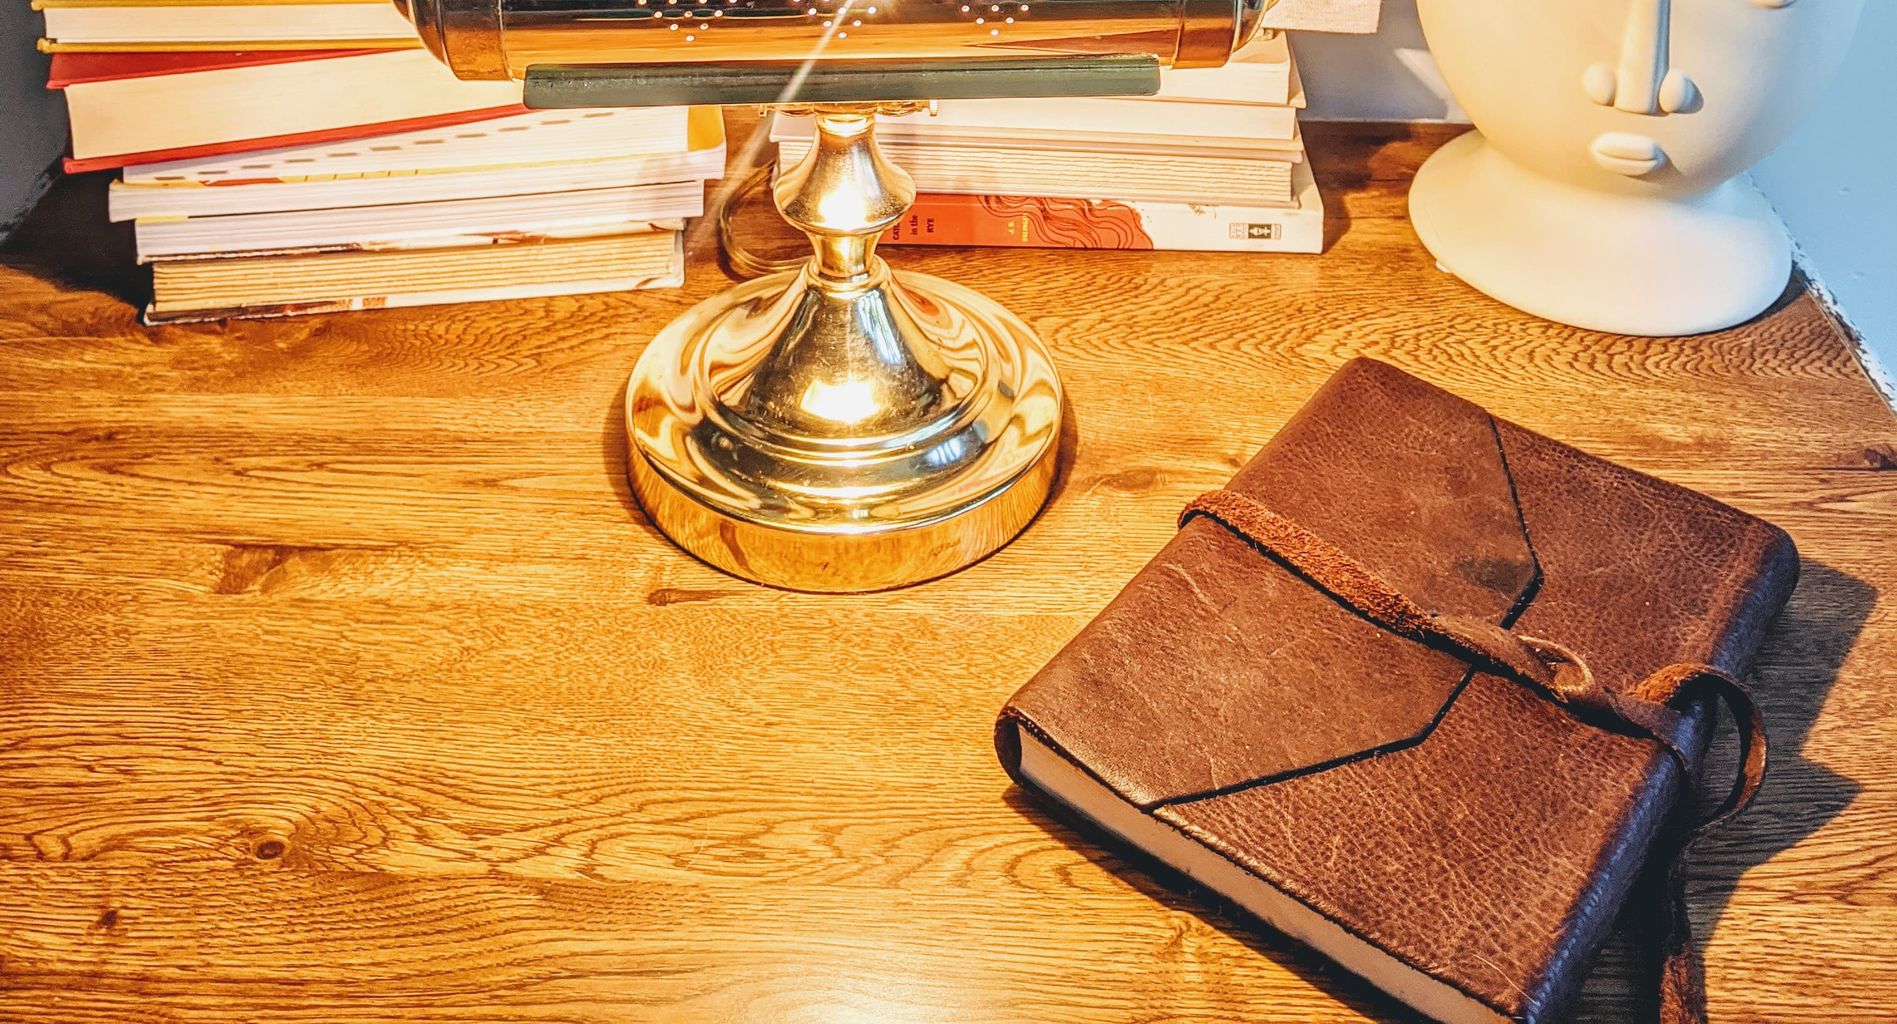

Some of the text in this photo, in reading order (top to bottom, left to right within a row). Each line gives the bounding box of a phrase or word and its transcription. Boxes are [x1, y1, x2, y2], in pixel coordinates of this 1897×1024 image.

[909, 215, 918, 236] in the
[927, 218, 935, 233] RYE
